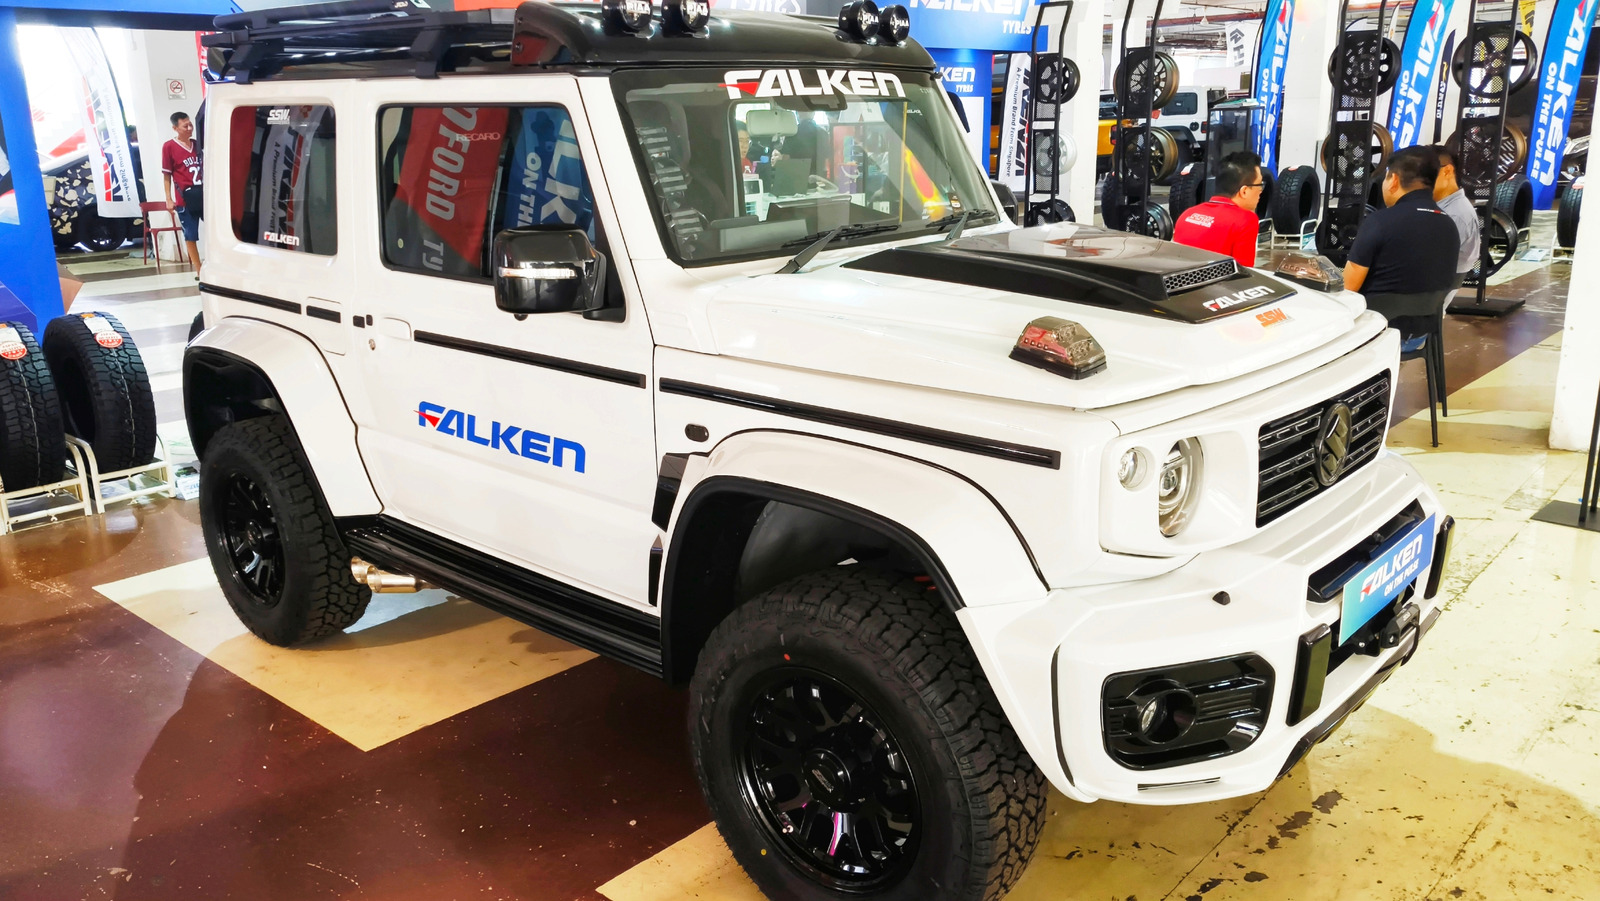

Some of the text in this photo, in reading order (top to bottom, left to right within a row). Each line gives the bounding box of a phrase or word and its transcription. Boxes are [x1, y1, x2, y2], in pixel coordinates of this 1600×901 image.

[719, 69, 906, 99] FALKEN
[1399, 70, 1410, 97] ON
[1010, 105, 1018, 127] Brand
[1392, 99, 1405, 129] THE
[1530, 62, 1558, 180] ON THE PULSE
[455, 132, 501, 142] RECARO
[522, 152, 542, 188] ON
[264, 231, 300, 246] FALKEN
[1202, 285, 1275, 312] FALKEN
[1255, 307, 1288, 328] SSW
[414, 400, 586, 474] FALKEN
[1360, 534, 1423, 603] FALKEN
[1384, 558, 1420, 597] ON THE PULSE
